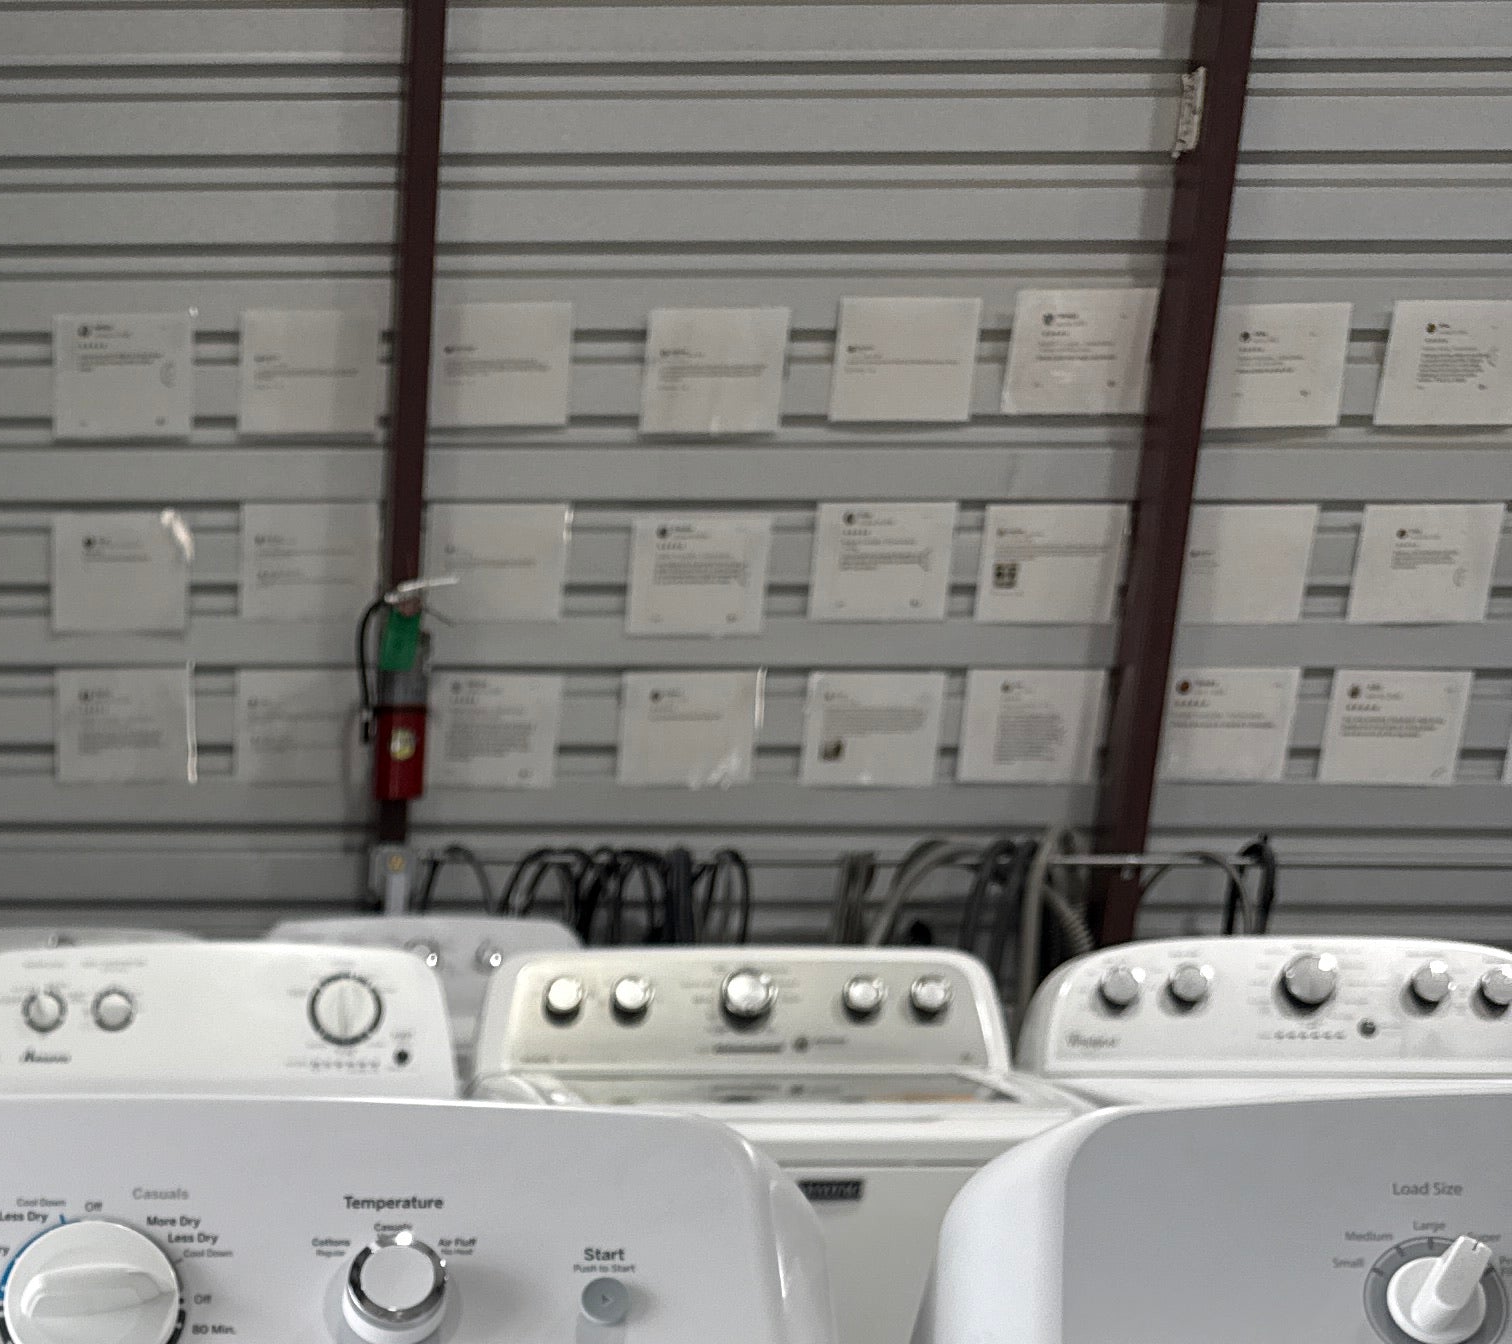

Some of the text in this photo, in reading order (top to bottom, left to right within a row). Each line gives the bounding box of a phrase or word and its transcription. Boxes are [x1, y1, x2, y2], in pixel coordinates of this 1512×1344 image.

[132, 1187, 189, 1200] Casuals
[1392, 1182, 1463, 1196] Load Size
[85, 1201, 103, 1212] Off
[344, 1195, 444, 1211] Temperature
[27, 1211, 49, 1223] Dry
[146, 1216, 201, 1229] More Dry
[1413, 1221, 1446, 1233] Large
[167, 1233, 219, 1245] Less Dry
[1345, 1231, 1394, 1242] Medium
[454, 1238, 478, 1247] Fluff
[183, 1249, 233, 1258] Cool Down
[583, 1247, 625, 1261] Start
[1332, 1258, 1365, 1268] Small
[573, 1264, 636, 1274] Push to Start
[193, 1294, 212, 1305] Off
[192, 1325, 209, 1334] 80
